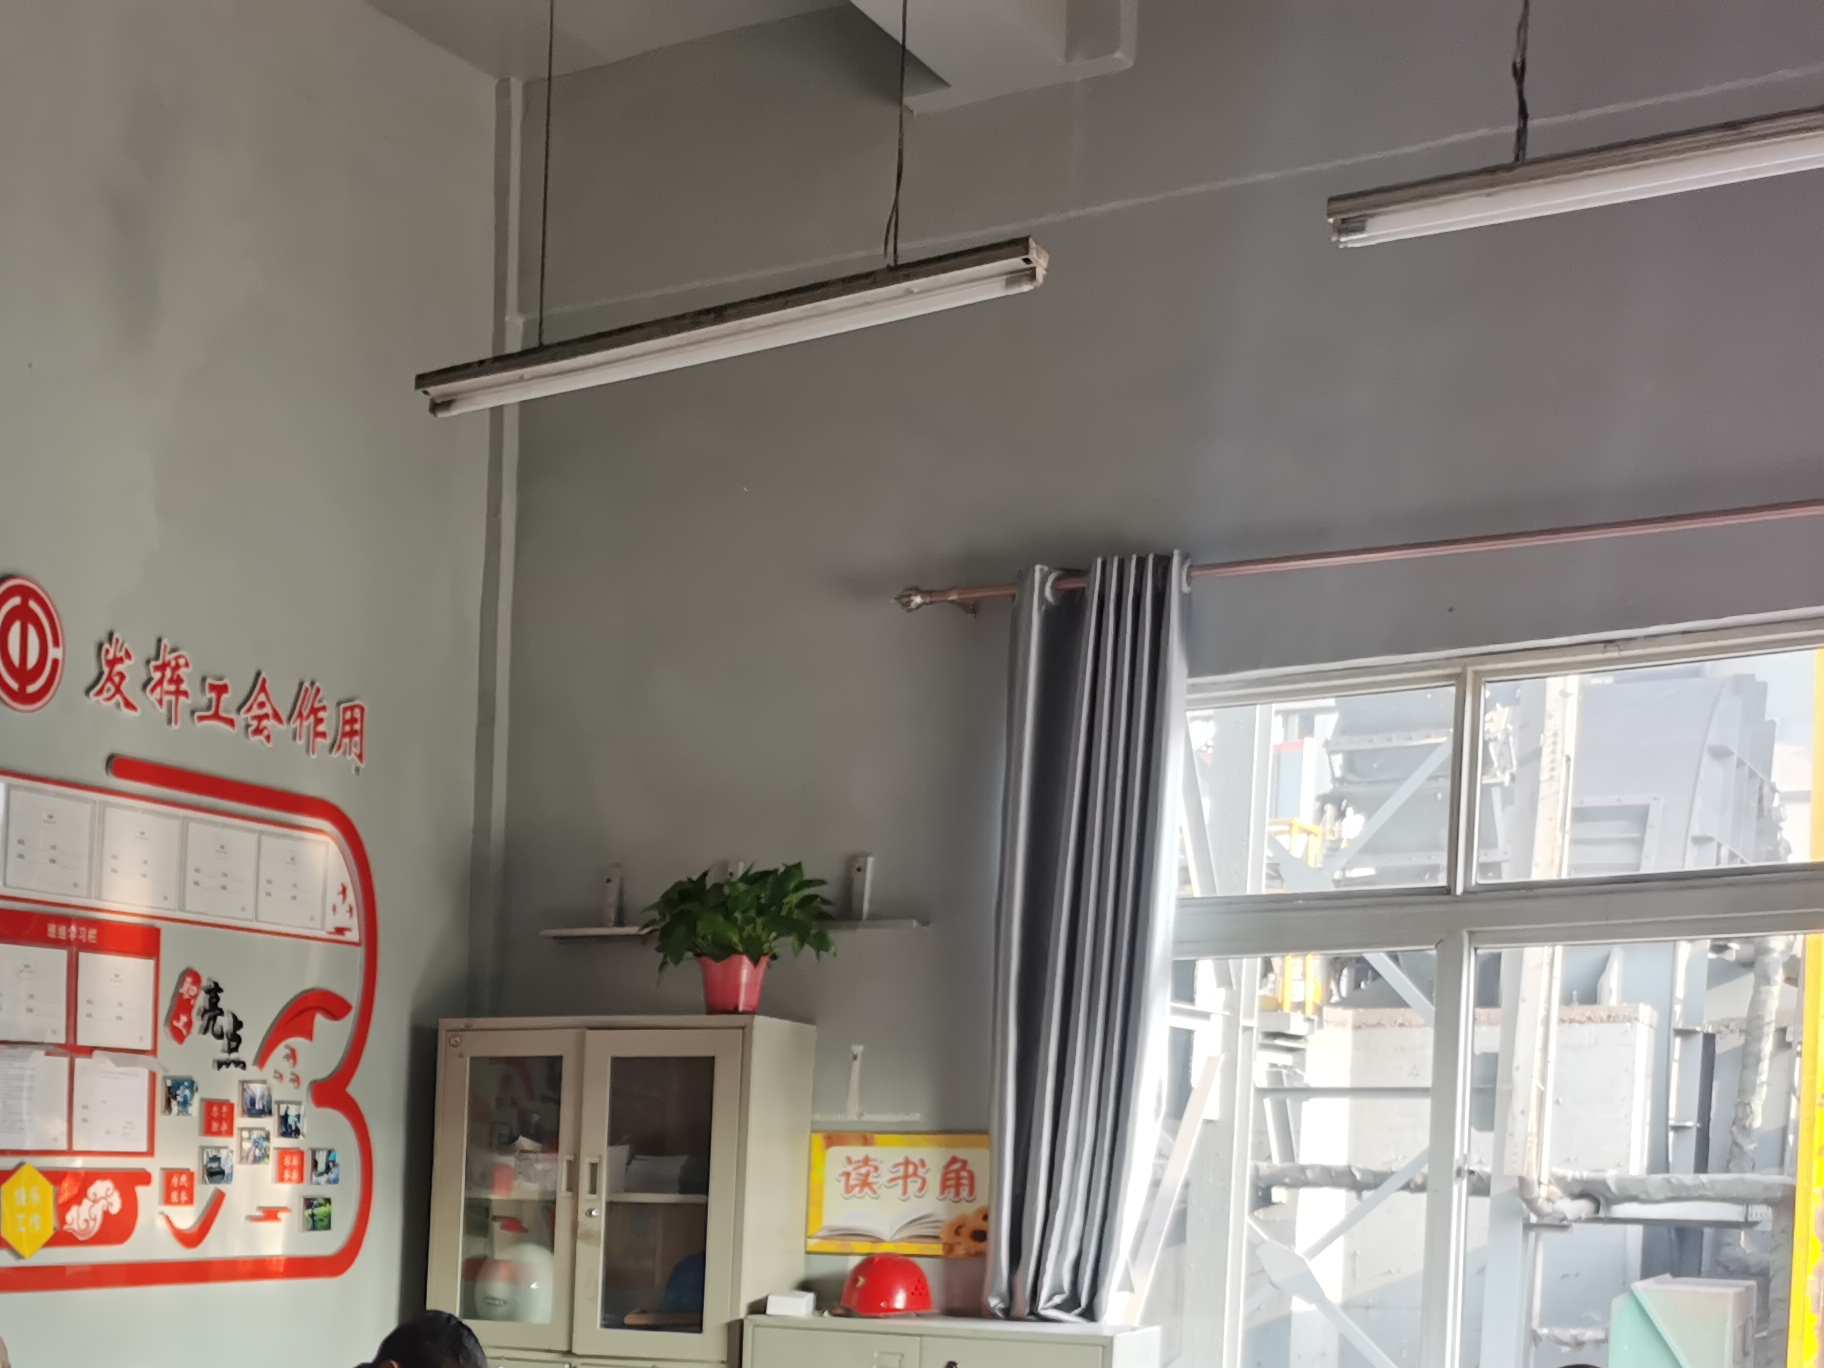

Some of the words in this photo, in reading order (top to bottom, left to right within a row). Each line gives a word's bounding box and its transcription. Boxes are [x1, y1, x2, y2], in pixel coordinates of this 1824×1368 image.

[87, 630, 370, 766] 发挥工会作用
[200, 980, 246, 1070] 亮点
[838, 1153, 977, 1199] 读书角
